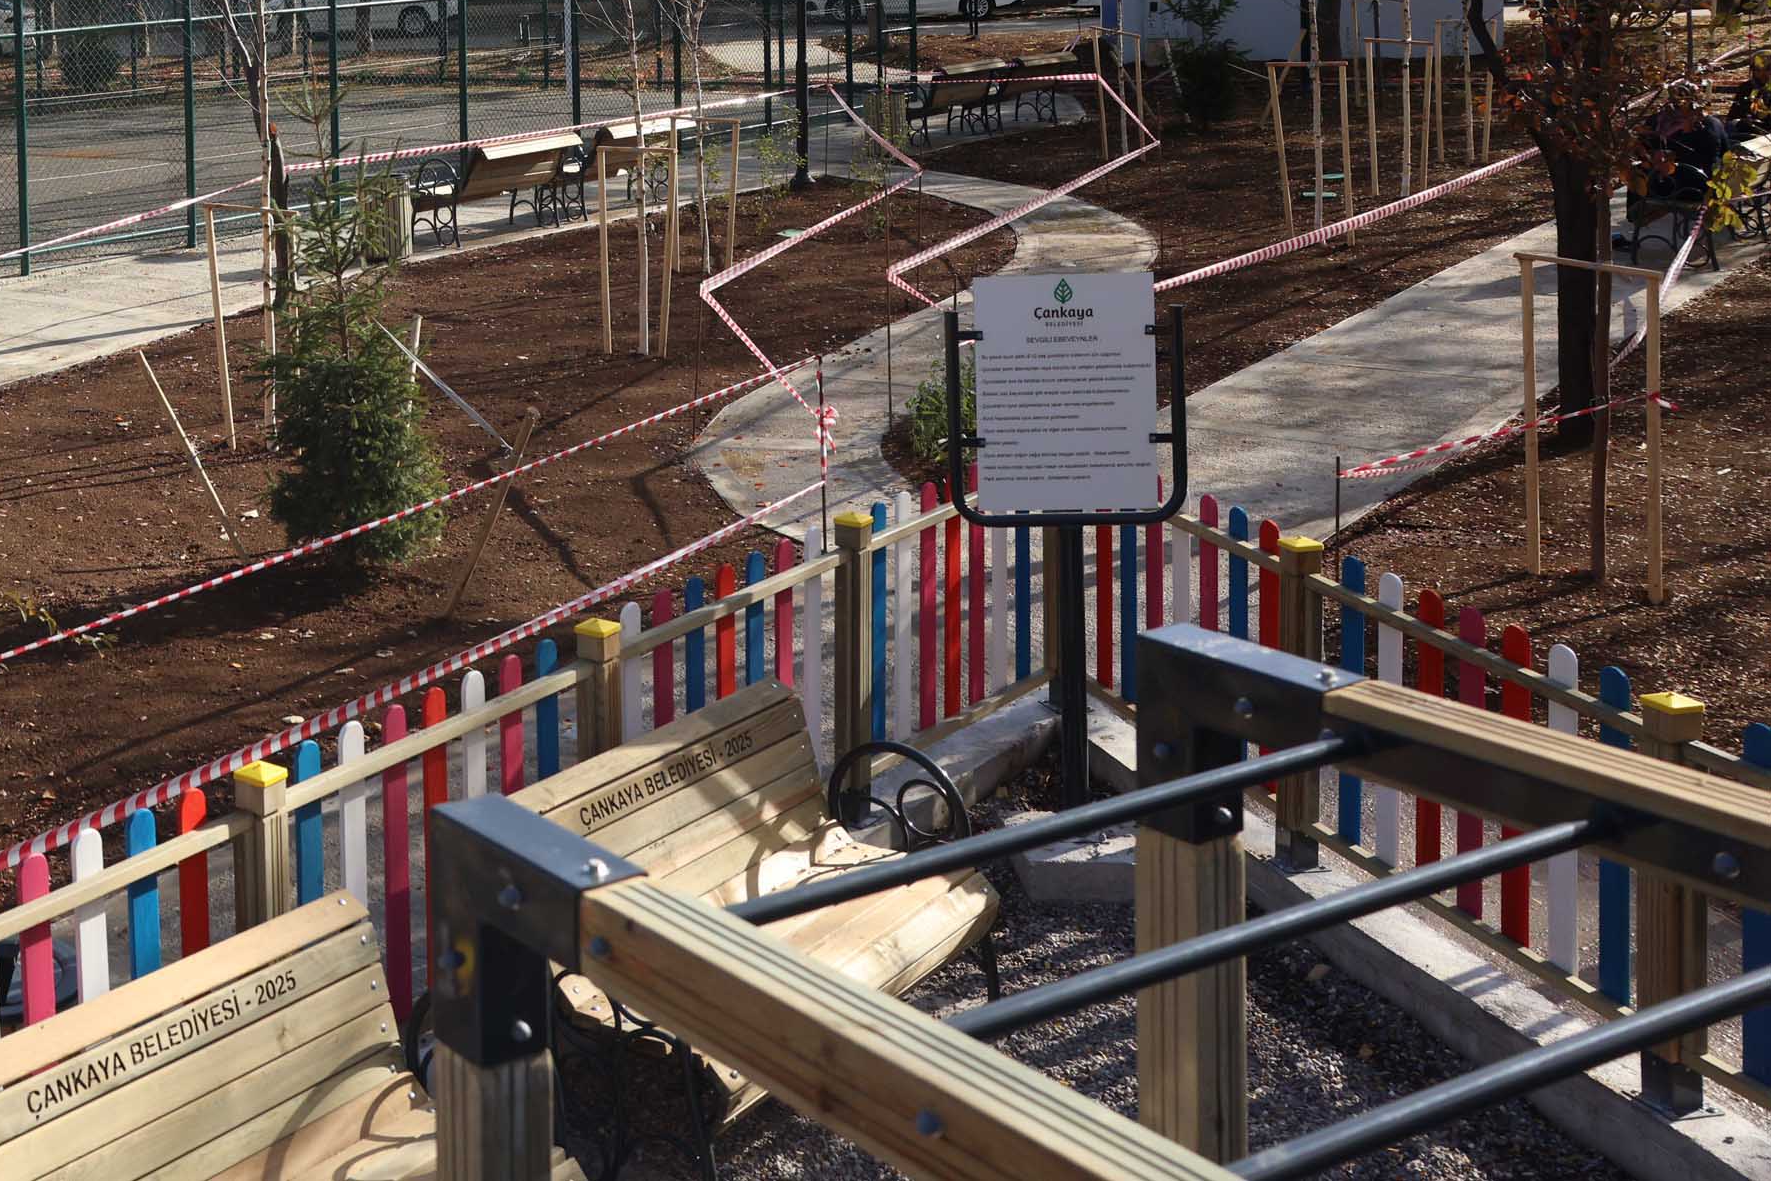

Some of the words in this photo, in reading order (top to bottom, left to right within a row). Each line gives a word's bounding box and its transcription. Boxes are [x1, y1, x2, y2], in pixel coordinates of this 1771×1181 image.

[1034, 306, 1094, 321] Çankaya
[579, 783, 645, 830] ÇANKAYA
[644, 742, 717, 796] BELEDİYESİ
[724, 730, 754, 757] 2025
[27, 1051, 127, 1120] ÇANKAYA
[130, 990, 241, 1066] BELEDİYESİ
[255, 970, 297, 1006] 2025
